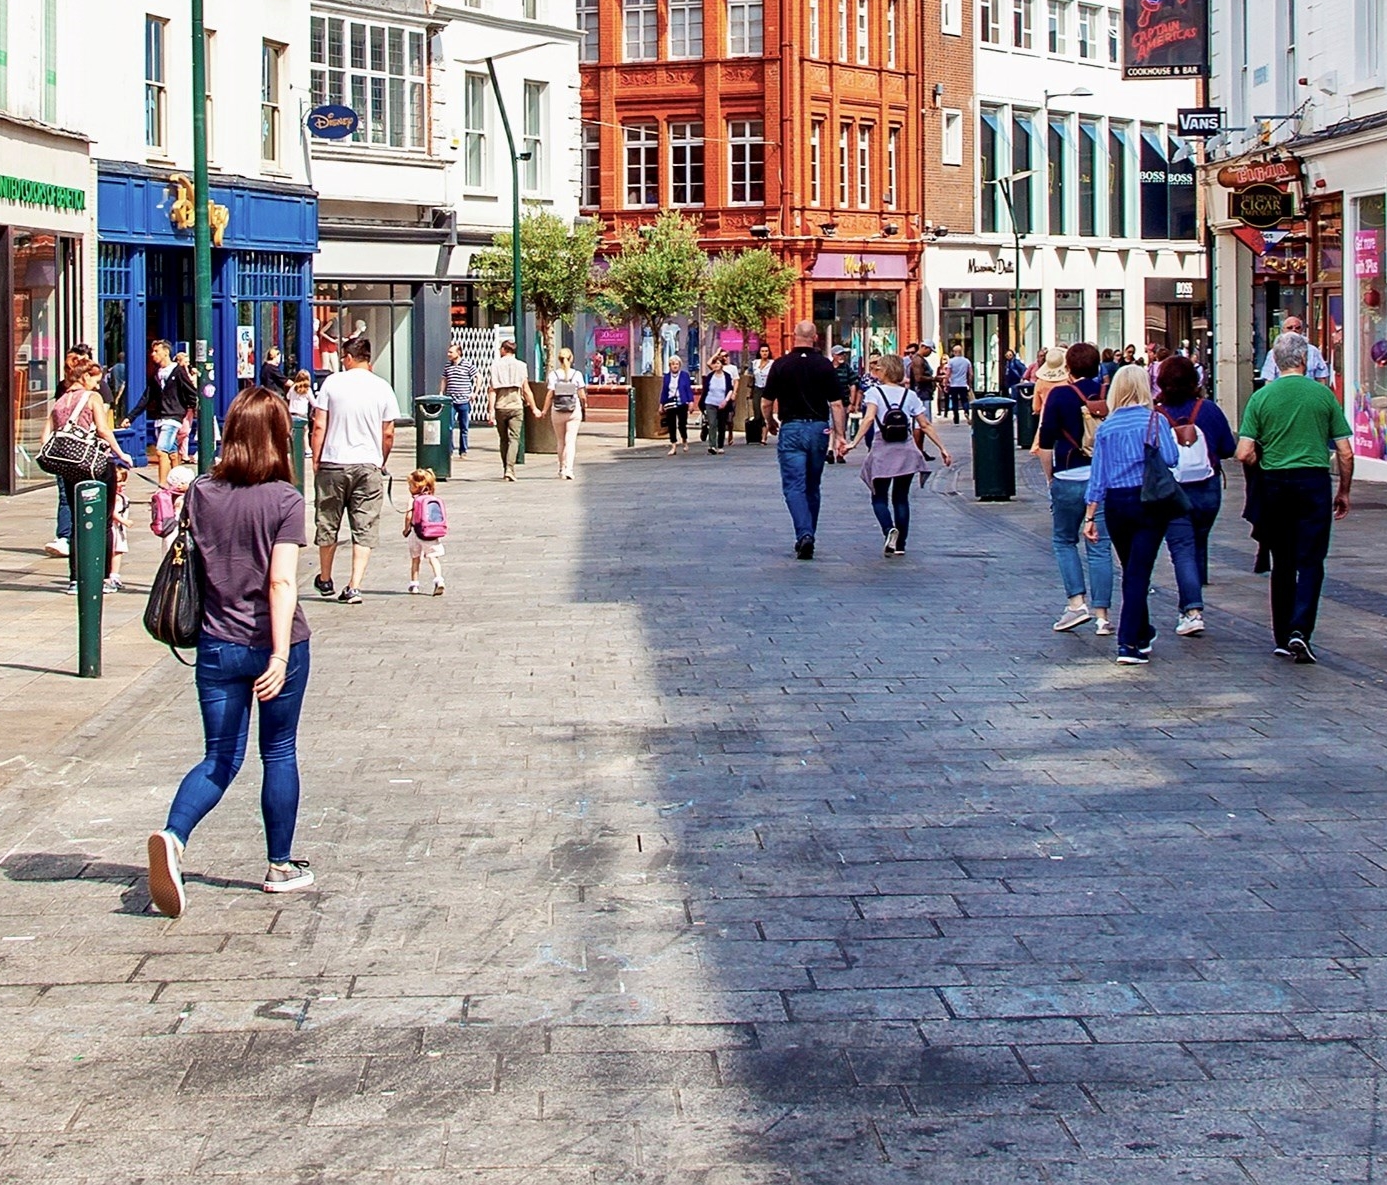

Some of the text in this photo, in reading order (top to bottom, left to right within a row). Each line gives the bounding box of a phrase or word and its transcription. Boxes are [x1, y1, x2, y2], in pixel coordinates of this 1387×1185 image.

[1131, 19, 1181, 48] CAPTAIN
[1127, 66, 1198, 77] COOKHOUSE & BAR
[1178, 113, 1219, 130] VANS
[1139, 170, 1166, 181] BOSS
[1168, 173, 1193, 183] BOSS
[1240, 199, 1282, 211] CIGAR
